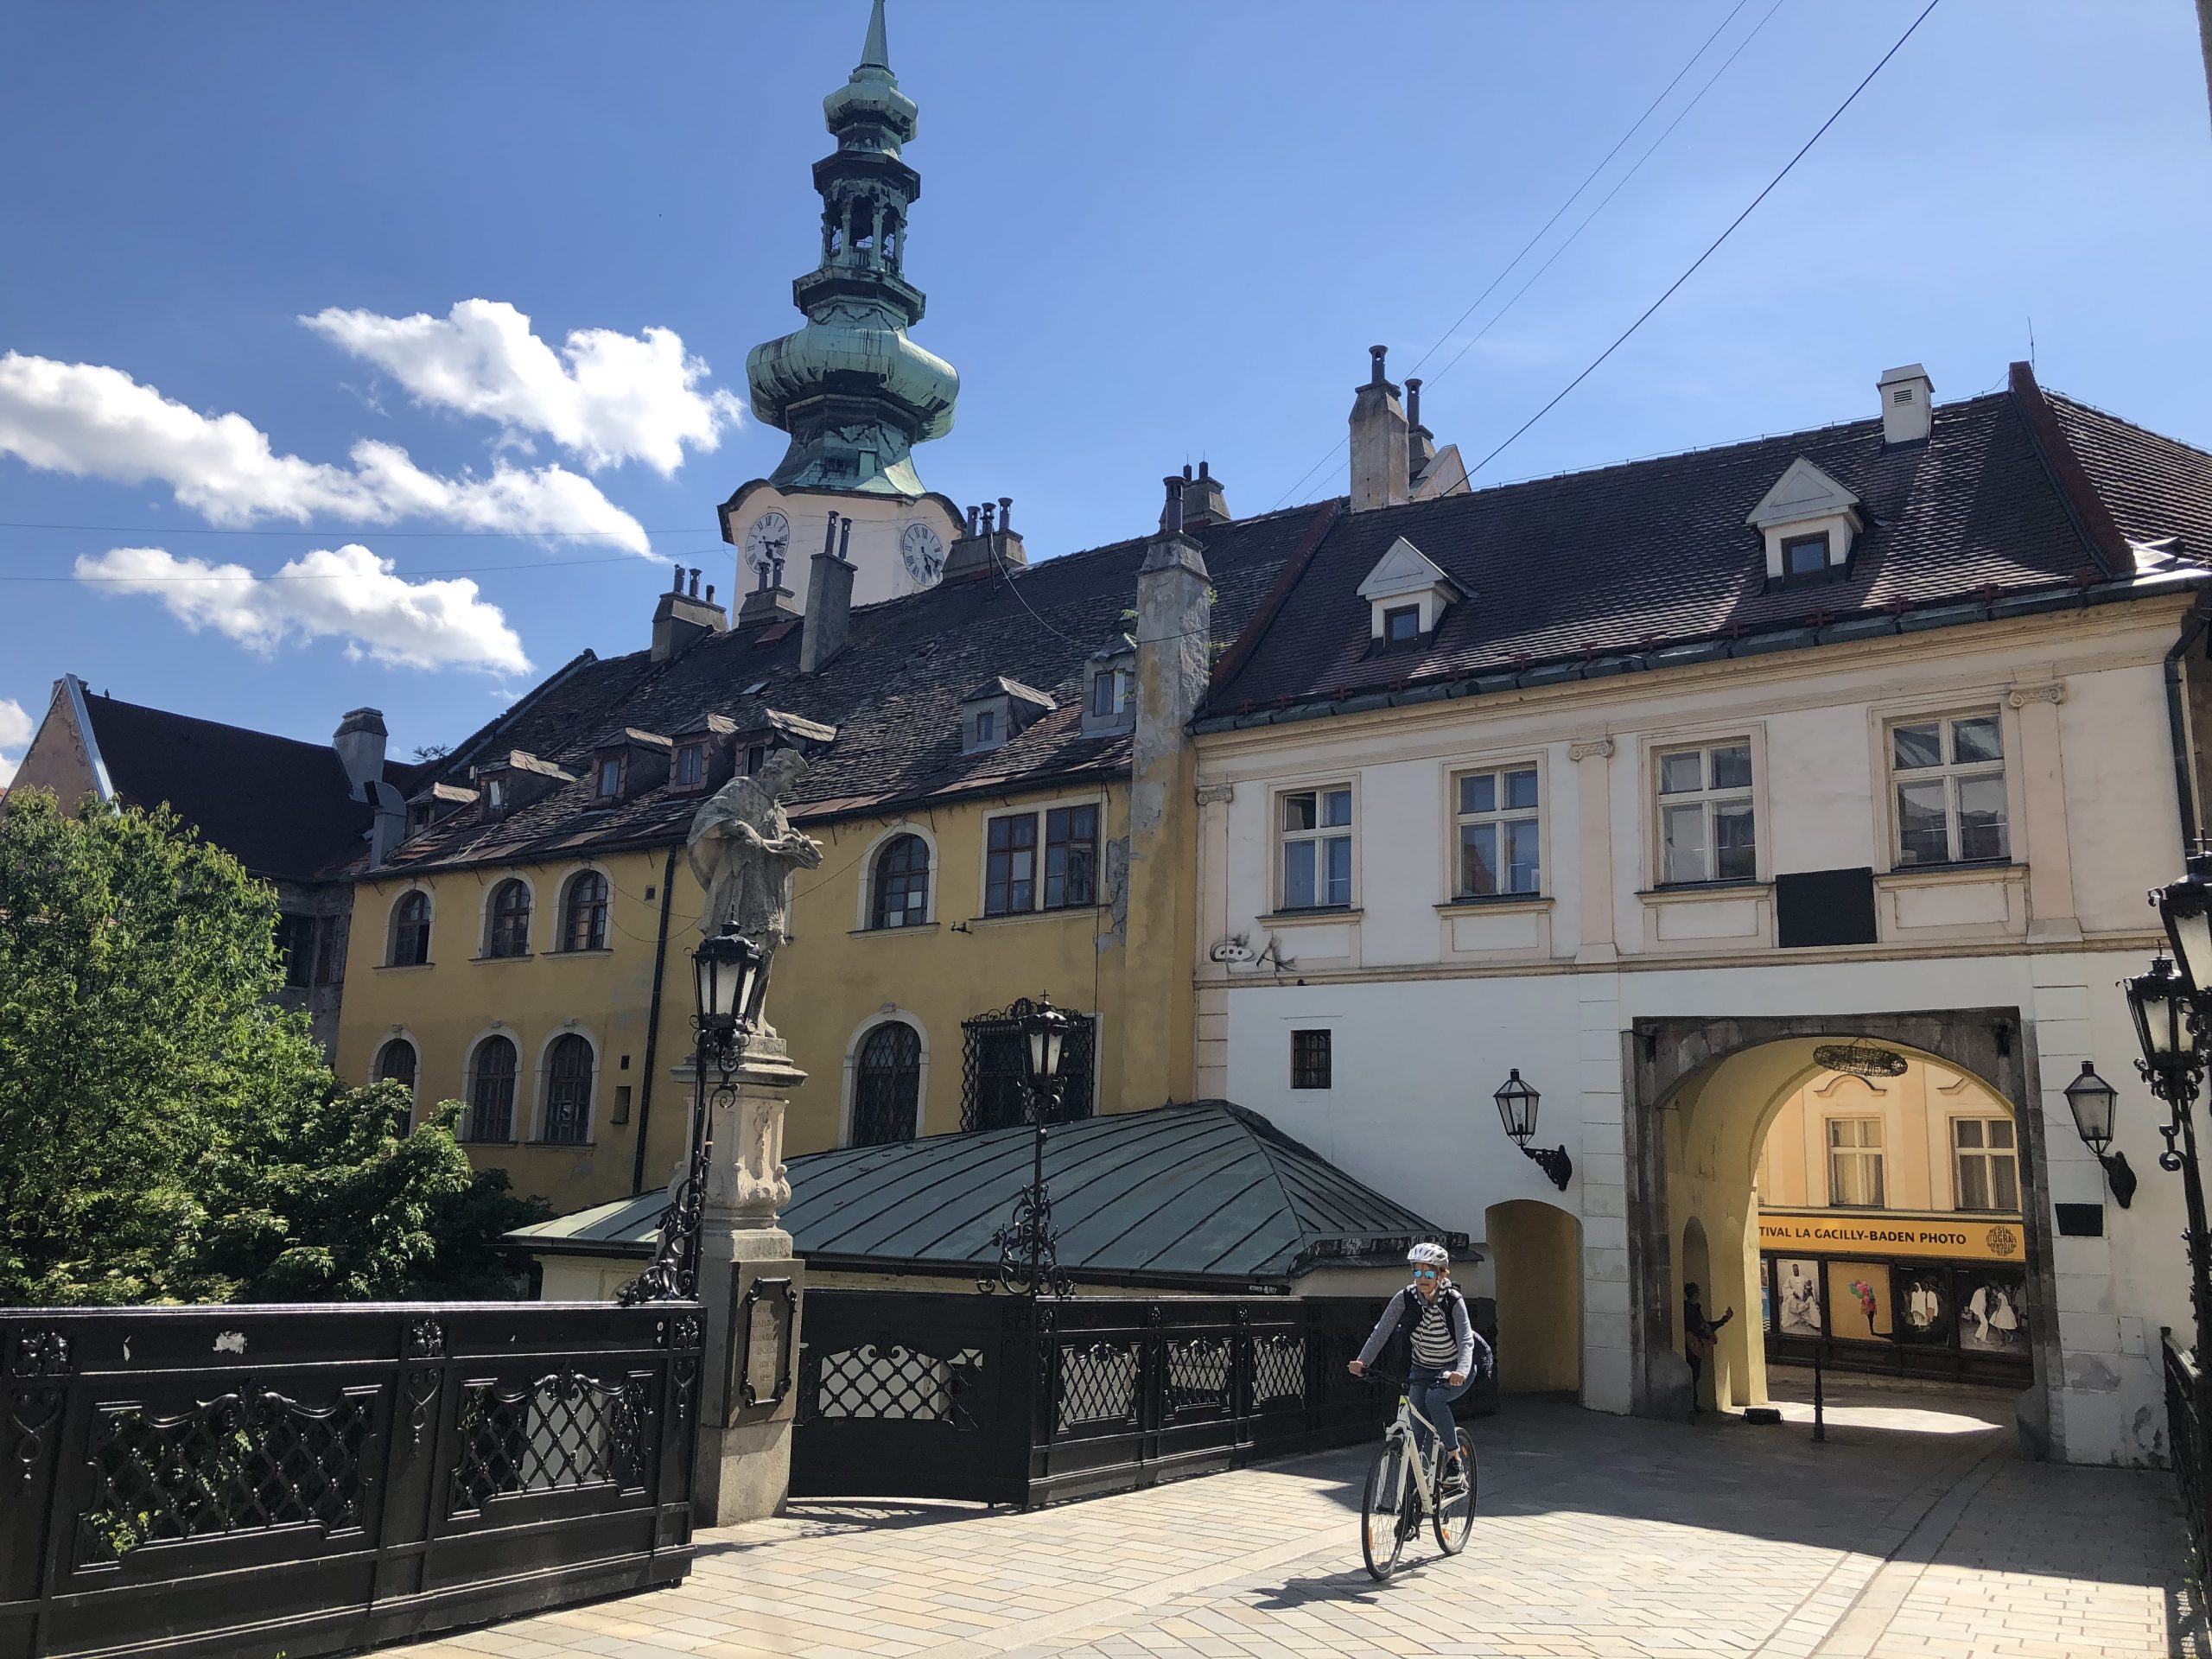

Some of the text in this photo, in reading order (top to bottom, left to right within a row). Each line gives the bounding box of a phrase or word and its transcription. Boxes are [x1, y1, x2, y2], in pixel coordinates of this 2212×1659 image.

[1796, 1228, 1811, 1238] LA
[1815, 1229, 1915, 1243] GACILLY-BADEN
[1919, 1232, 1967, 1245] PHOTO
